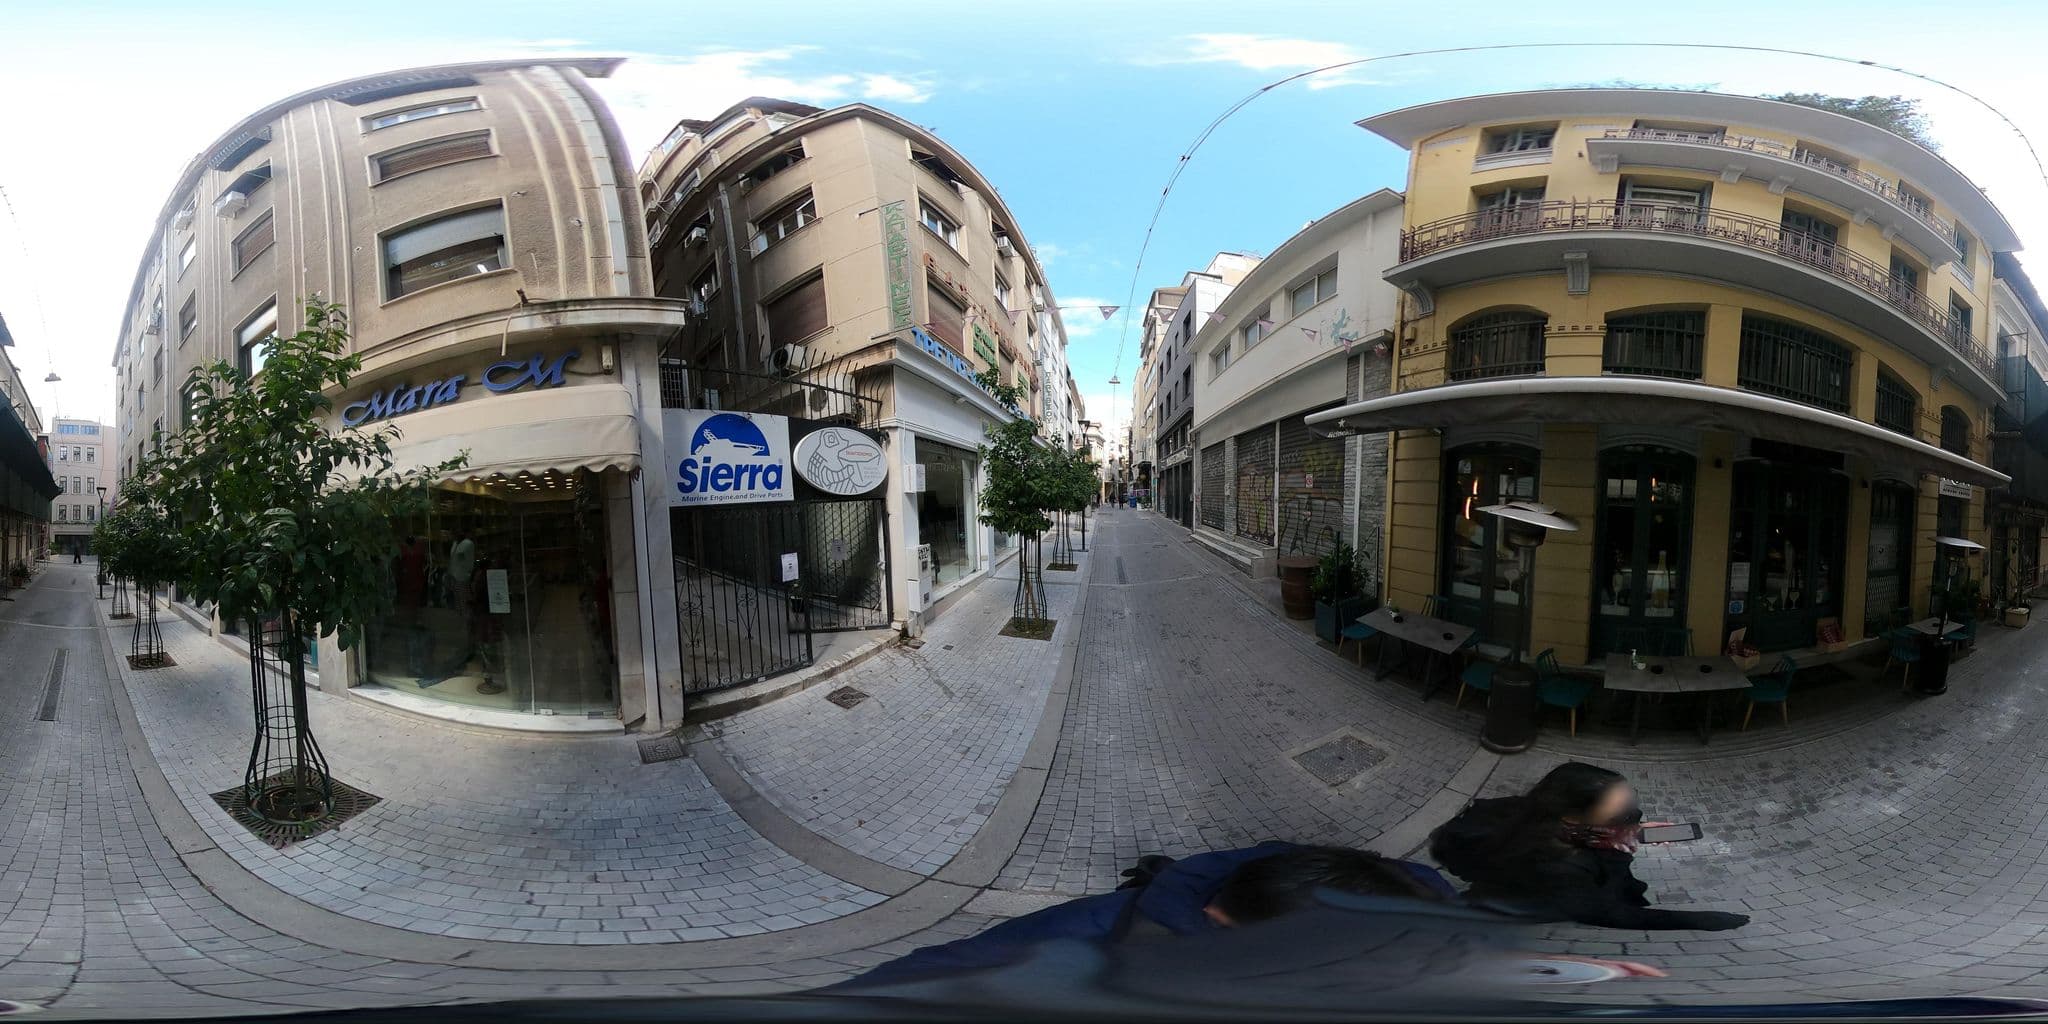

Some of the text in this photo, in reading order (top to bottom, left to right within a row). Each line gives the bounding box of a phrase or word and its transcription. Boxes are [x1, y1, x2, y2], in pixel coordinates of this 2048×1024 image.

[341, 349, 580, 427] Mara M
[677, 456, 783, 493] Sierra
